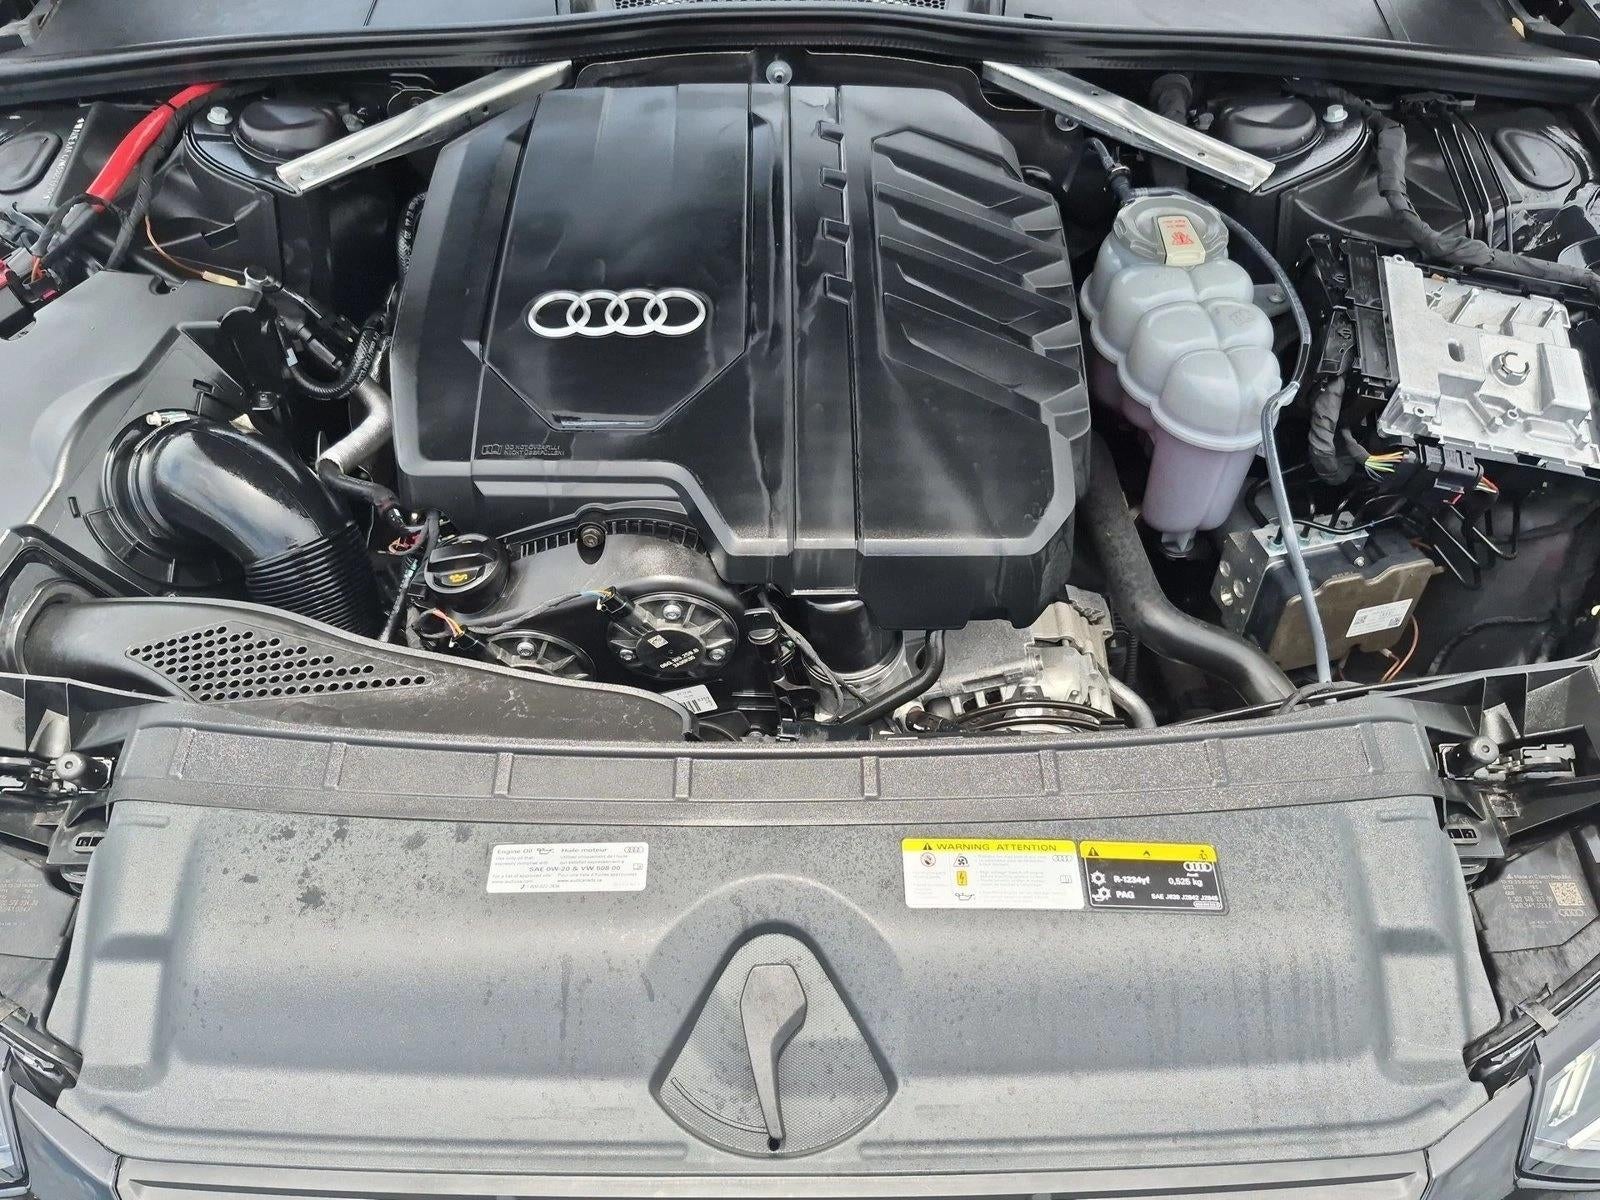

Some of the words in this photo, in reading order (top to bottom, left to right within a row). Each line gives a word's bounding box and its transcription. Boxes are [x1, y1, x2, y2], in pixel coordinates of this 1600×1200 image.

[936, 843, 990, 851] WARNING
[997, 843, 1057, 852] ATTENTION
[1113, 875, 1150, 885] R-1234yf
[1168, 877, 1191, 886] 0,525
[1192, 878, 1203, 887] kg
[1115, 890, 1135, 899] PAG
